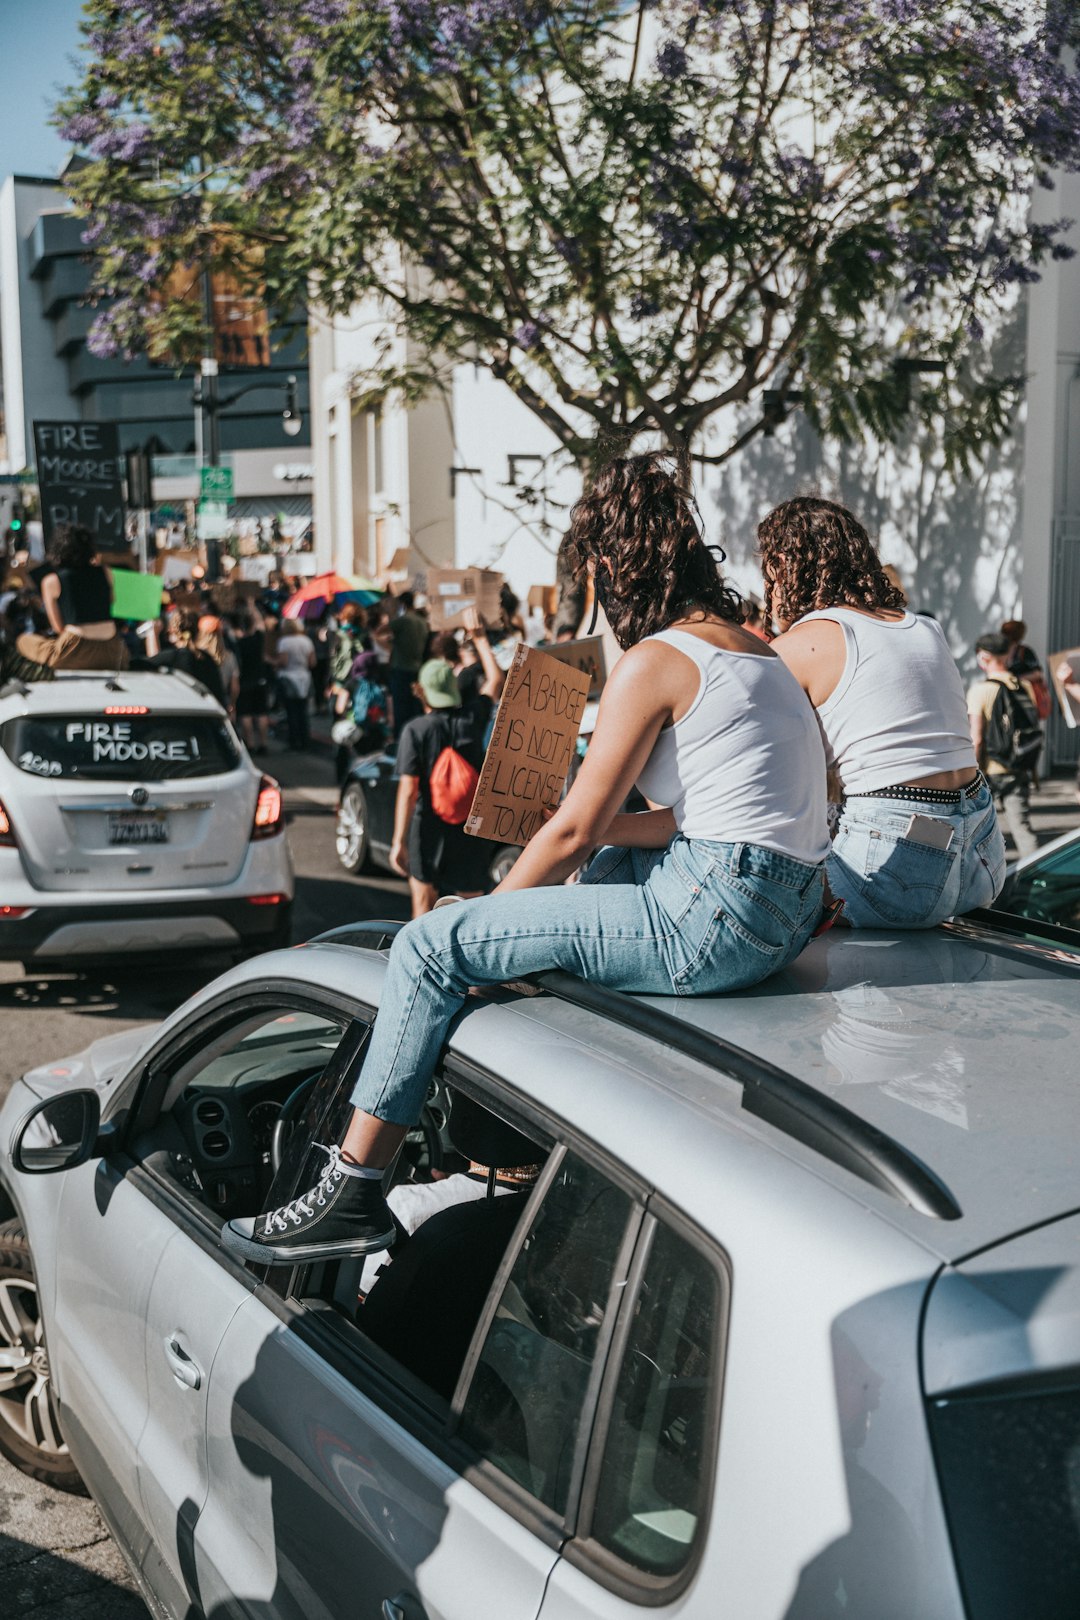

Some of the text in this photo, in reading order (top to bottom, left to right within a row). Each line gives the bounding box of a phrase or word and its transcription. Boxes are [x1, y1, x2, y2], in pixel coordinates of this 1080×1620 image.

[38, 425, 102, 451] FIRE
[41, 456, 115, 482] MOORE
[512, 669, 531, 708] A
[533, 674, 586, 725] BADGE
[66, 722, 131, 742] FIRE
[505, 719, 573, 766] IS NOT A
[92, 735, 200, 762] MOORE!
[491, 760, 565, 807] LICENSE
[493, 804, 514, 838] TO
